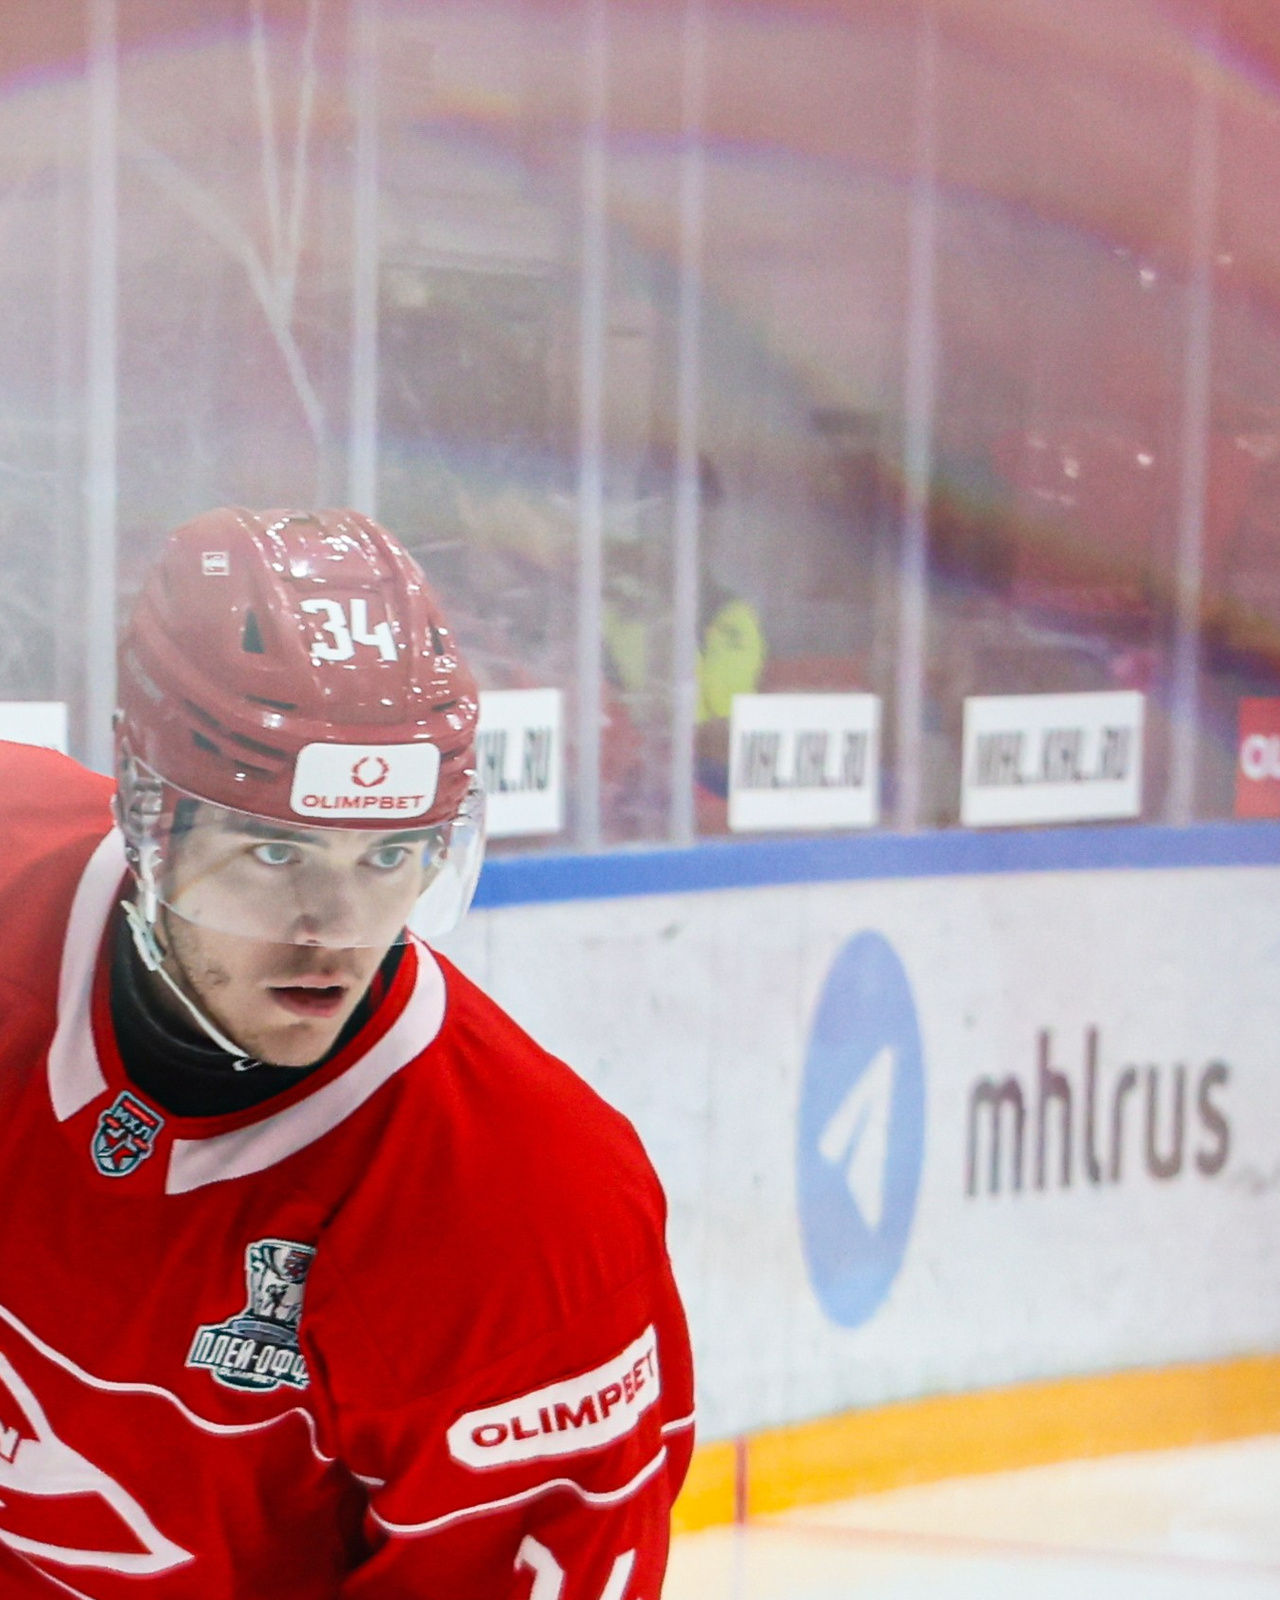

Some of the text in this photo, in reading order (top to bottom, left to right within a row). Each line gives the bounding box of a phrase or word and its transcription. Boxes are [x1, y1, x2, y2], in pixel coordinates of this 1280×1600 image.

[300, 597, 398, 662] 34
[302, 794, 425, 810] OLIMPBET
[965, 1022, 1231, 1198] mhlrus
[471, 1348, 655, 1448] OLIMPBET
